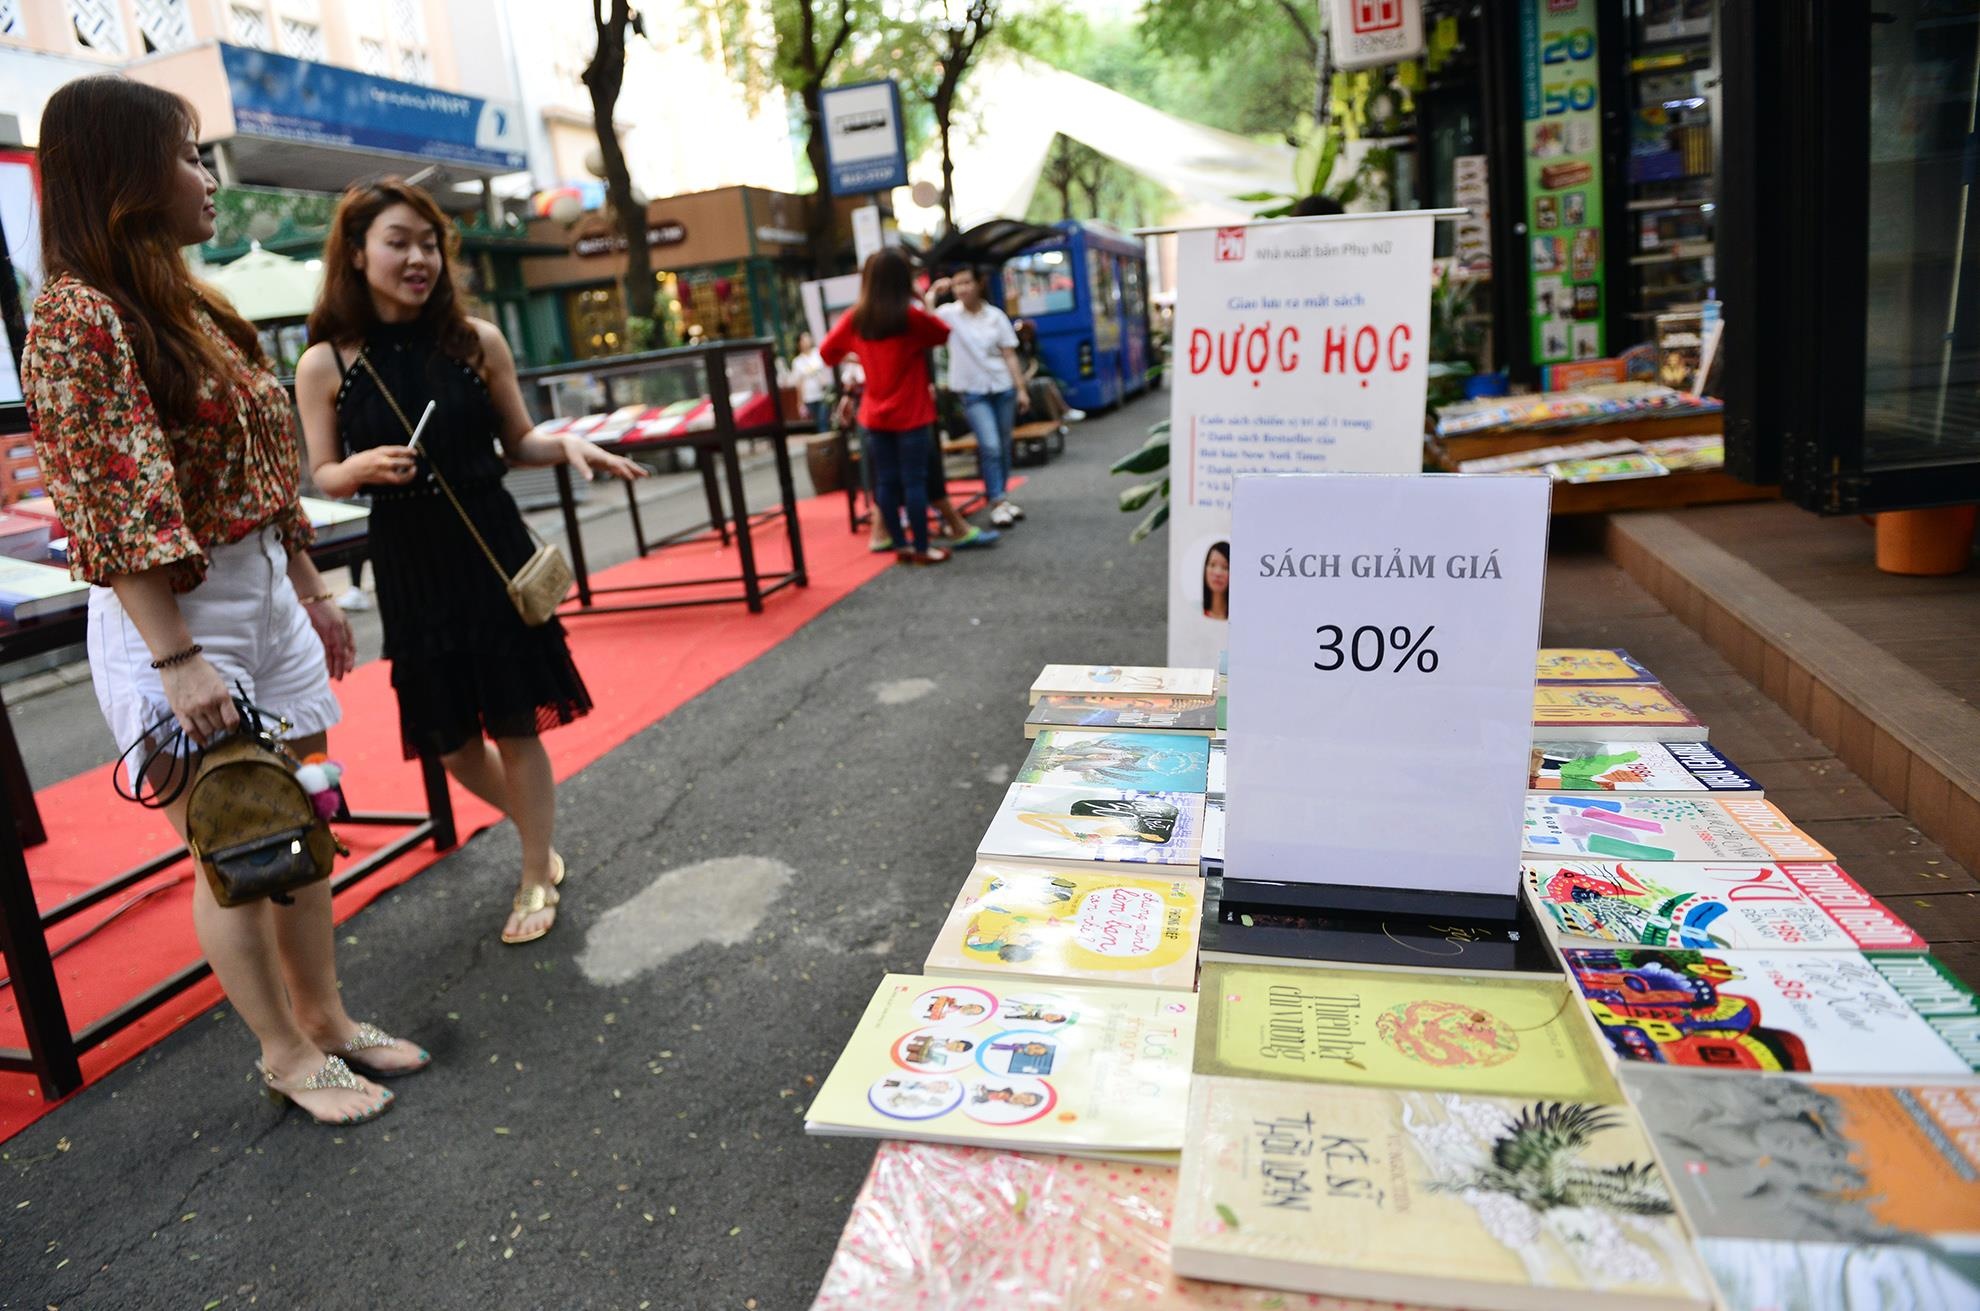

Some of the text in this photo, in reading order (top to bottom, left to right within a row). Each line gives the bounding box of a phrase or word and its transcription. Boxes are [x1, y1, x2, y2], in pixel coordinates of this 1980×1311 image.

[1543, 27, 1595, 64] 20
[1545, 79, 1597, 116] 50
[1227, 296, 1258, 310] Giao
[1334, 293, 1365, 307] sách
[1189, 321, 1412, 388] ĐƯỢC HỌC
[1259, 547, 1502, 579] SÁCH GIẢM GIÁ
[1313, 623, 1440, 674] 30%
[1108, 888, 1140, 916] làm
[1260, 985, 1314, 1062] chi vương
[1315, 994, 1361, 1038] Thiên
[1321, 1134, 1385, 1208] KẺ SĨ
